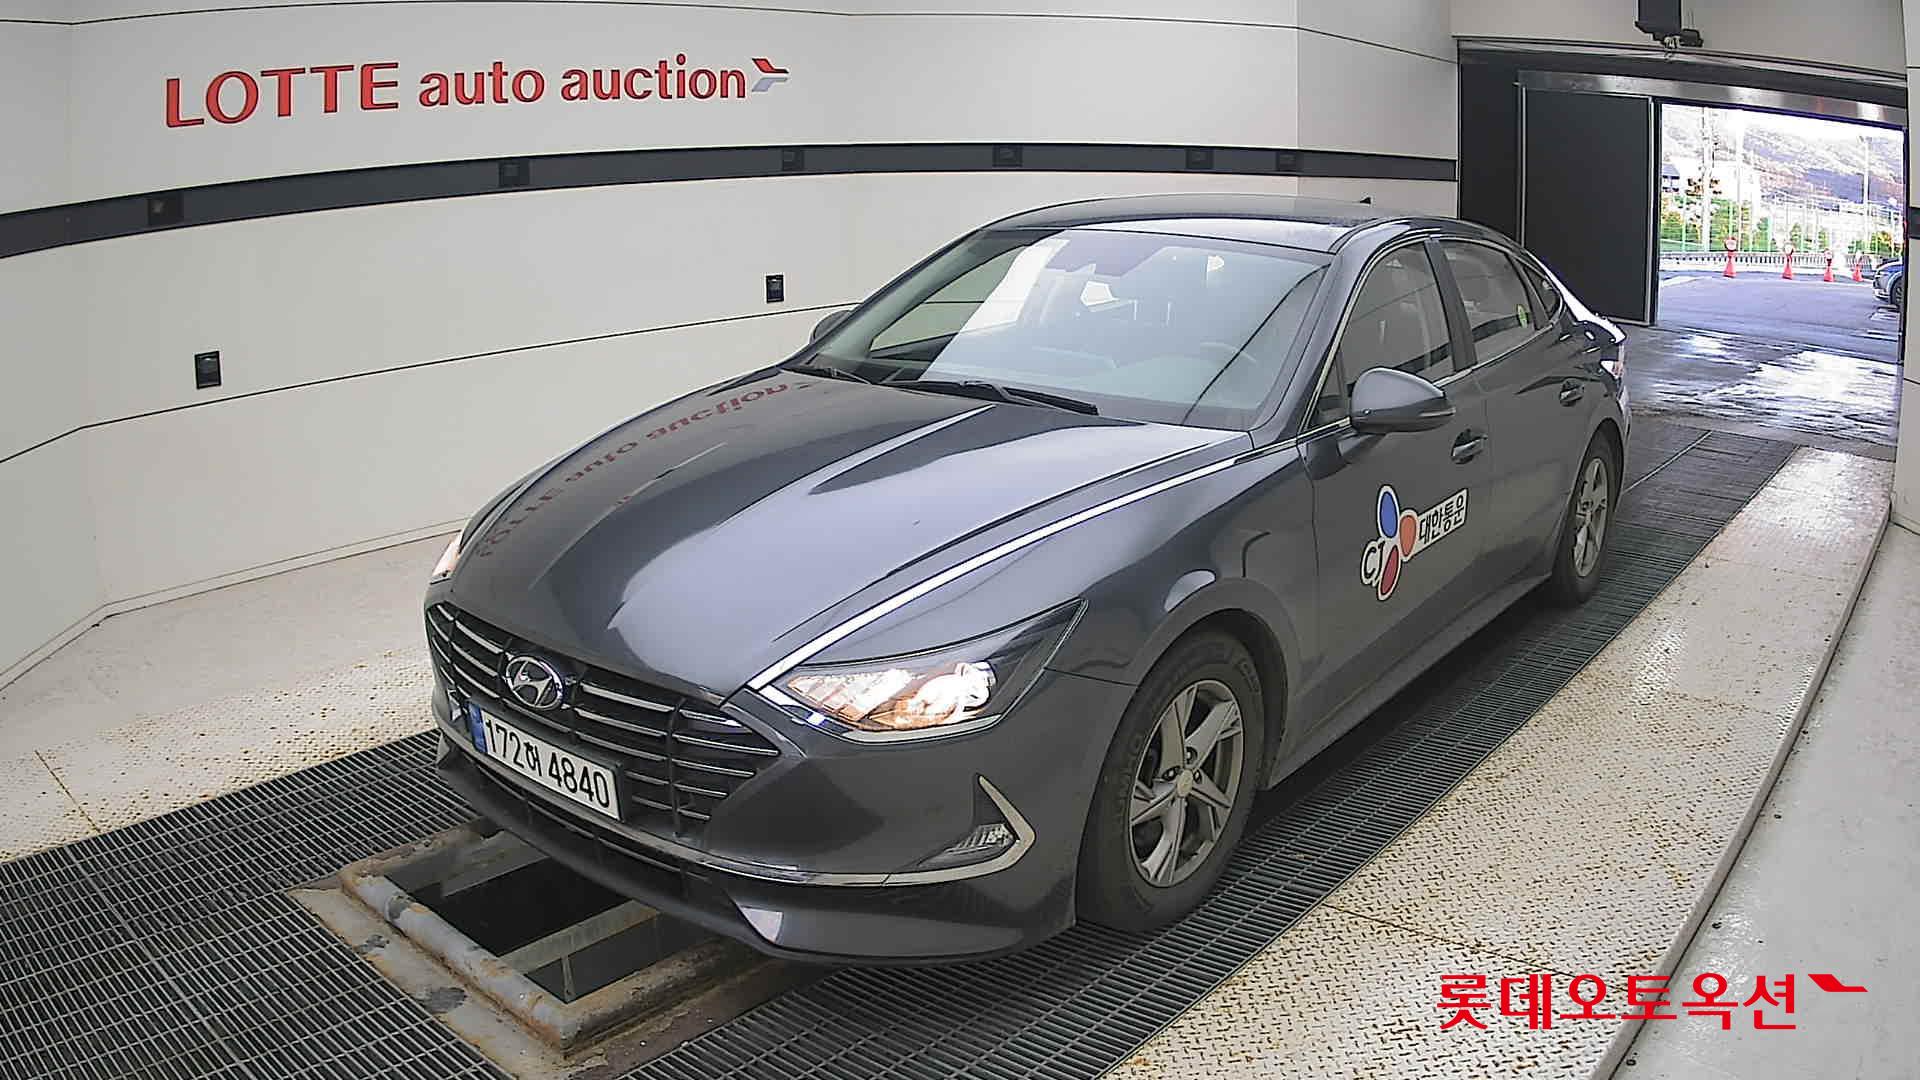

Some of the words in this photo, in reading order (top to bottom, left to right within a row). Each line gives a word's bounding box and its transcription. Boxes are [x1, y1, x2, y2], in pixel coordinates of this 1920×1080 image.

[165, 61, 399, 128] LOTTE
[418, 61, 545, 108] auto
[560, 53, 747, 102] auction
[1419, 494, 1465, 545] 대한통운
[1363, 540, 1386, 581] CJ
[485, 718, 543, 777] 172허
[549, 751, 610, 808] 4840
